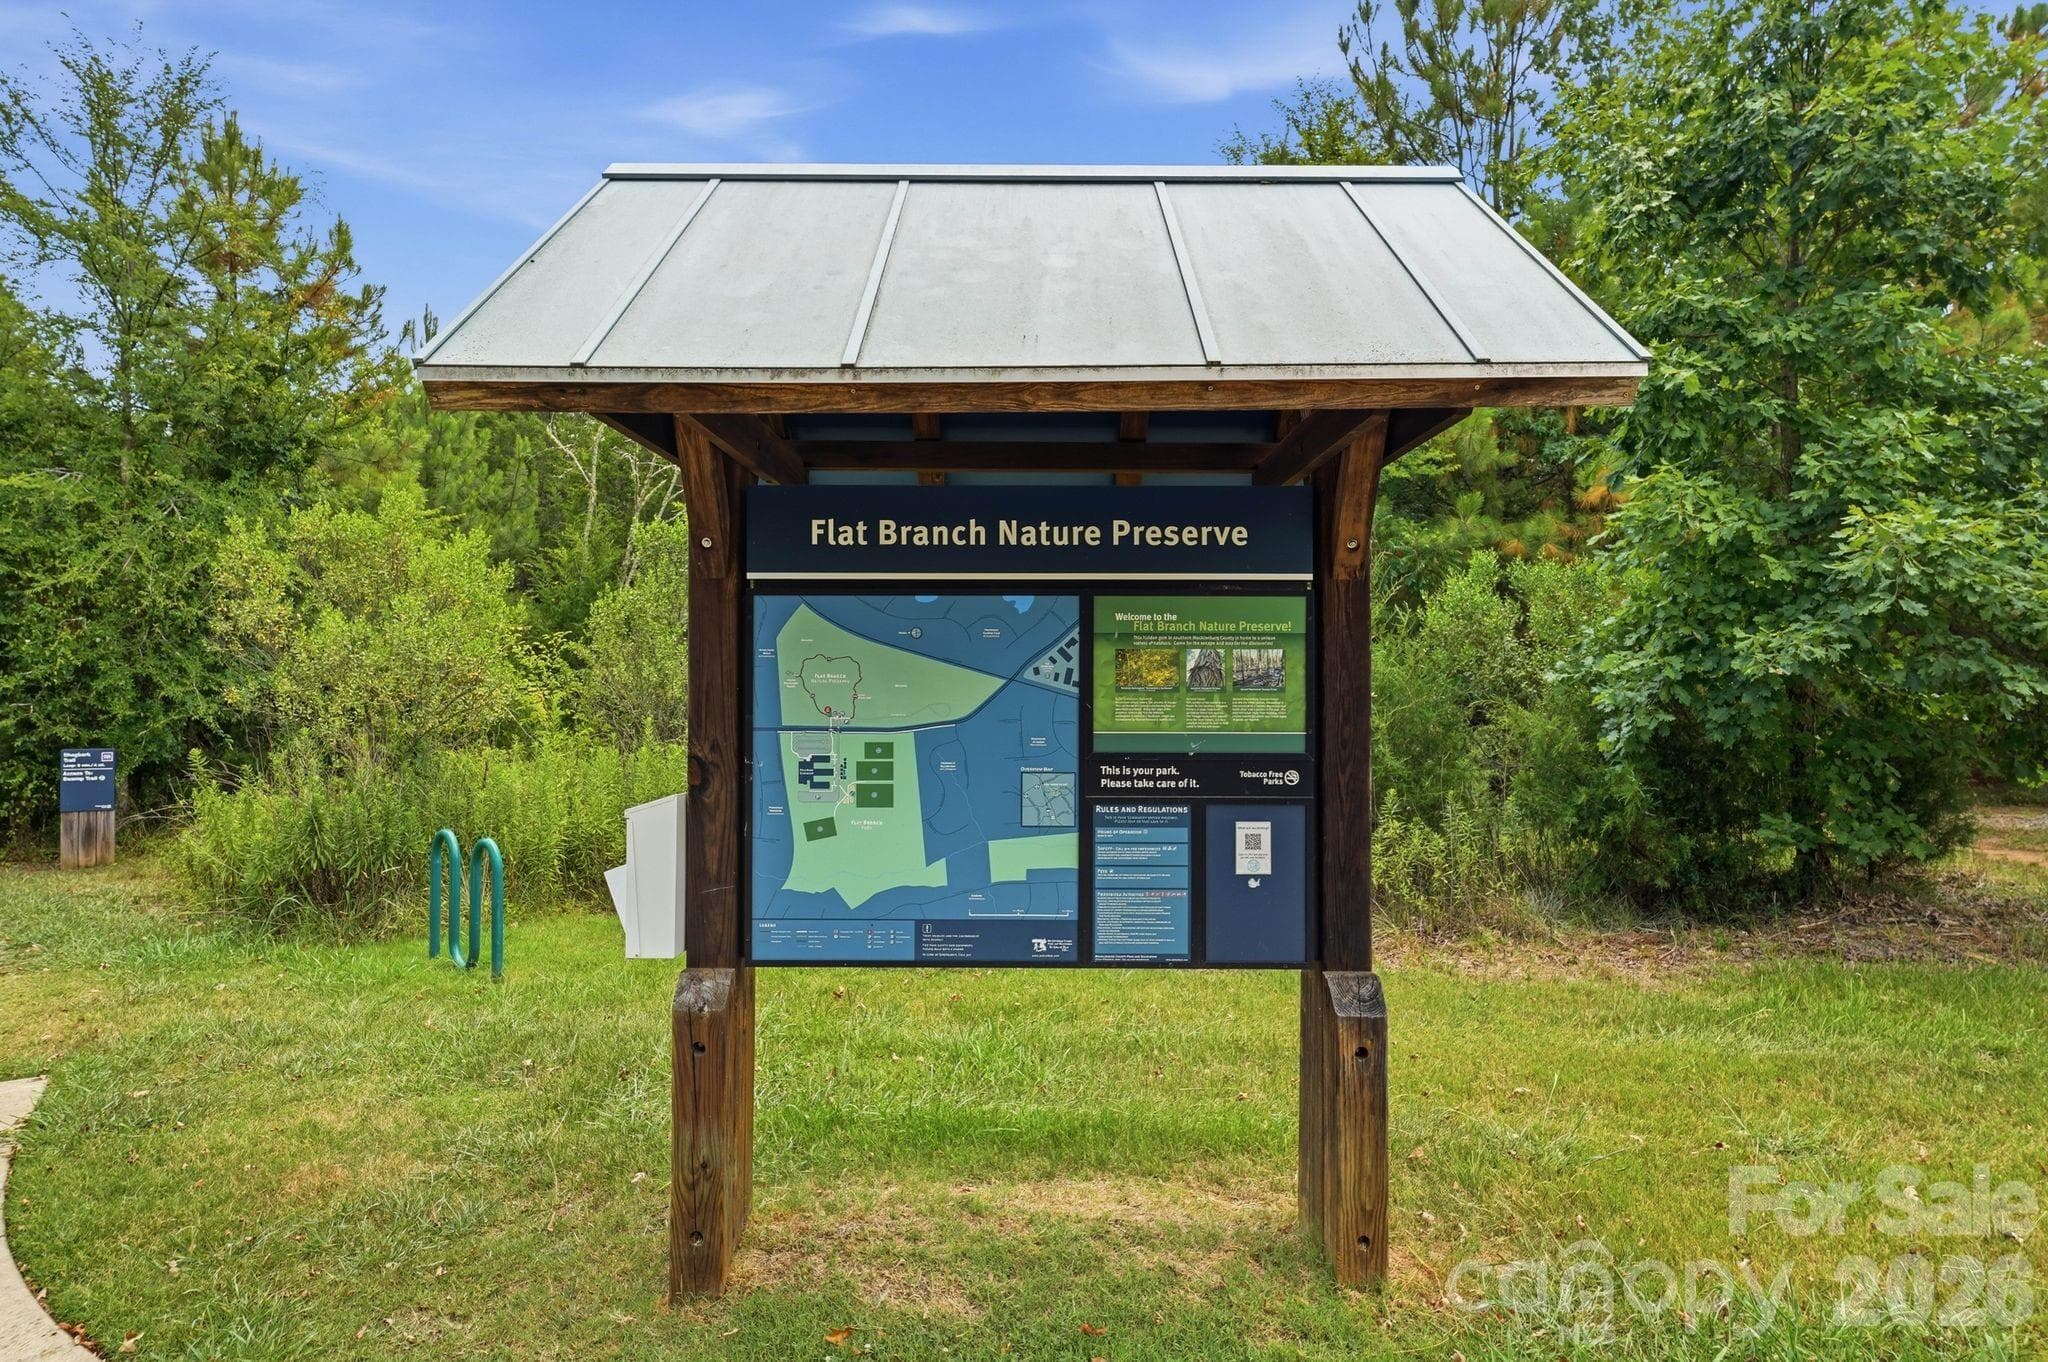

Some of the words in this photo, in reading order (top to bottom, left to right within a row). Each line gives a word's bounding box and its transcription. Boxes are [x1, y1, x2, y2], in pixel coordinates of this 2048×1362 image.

[810, 518, 868, 546] Flat
[878, 518, 987, 546] Branch
[998, 519, 1101, 546] Nature
[1112, 519, 1249, 546] Preserve
[1115, 612, 1152, 621] Welcome
[1153, 613, 1162, 621] to
[1163, 612, 1177, 621] the
[1133, 620, 1154, 632] Flat
[1157, 620, 1196, 632] Branch
[1199, 620, 1237, 632] Nature
[1239, 620, 1292, 632] Preserve!
[1100, 766, 1120, 775] This
[1122, 766, 1131, 775] is
[1132, 767, 1154, 777] your
[1156, 766, 1180, 777] park.
[1240, 770, 1268, 778] Tobacco
[1269, 770, 1283, 778] Free
[1101, 778, 1132, 788] Please
[1134, 778, 1154, 788] take
[1156, 780, 1176, 788] care
[1178, 778, 1189, 788] of
[1189, 778, 1200, 788] it.
[1095, 805, 1120, 813] RULES
[1137, 805, 1189, 814] REGULATIONS
